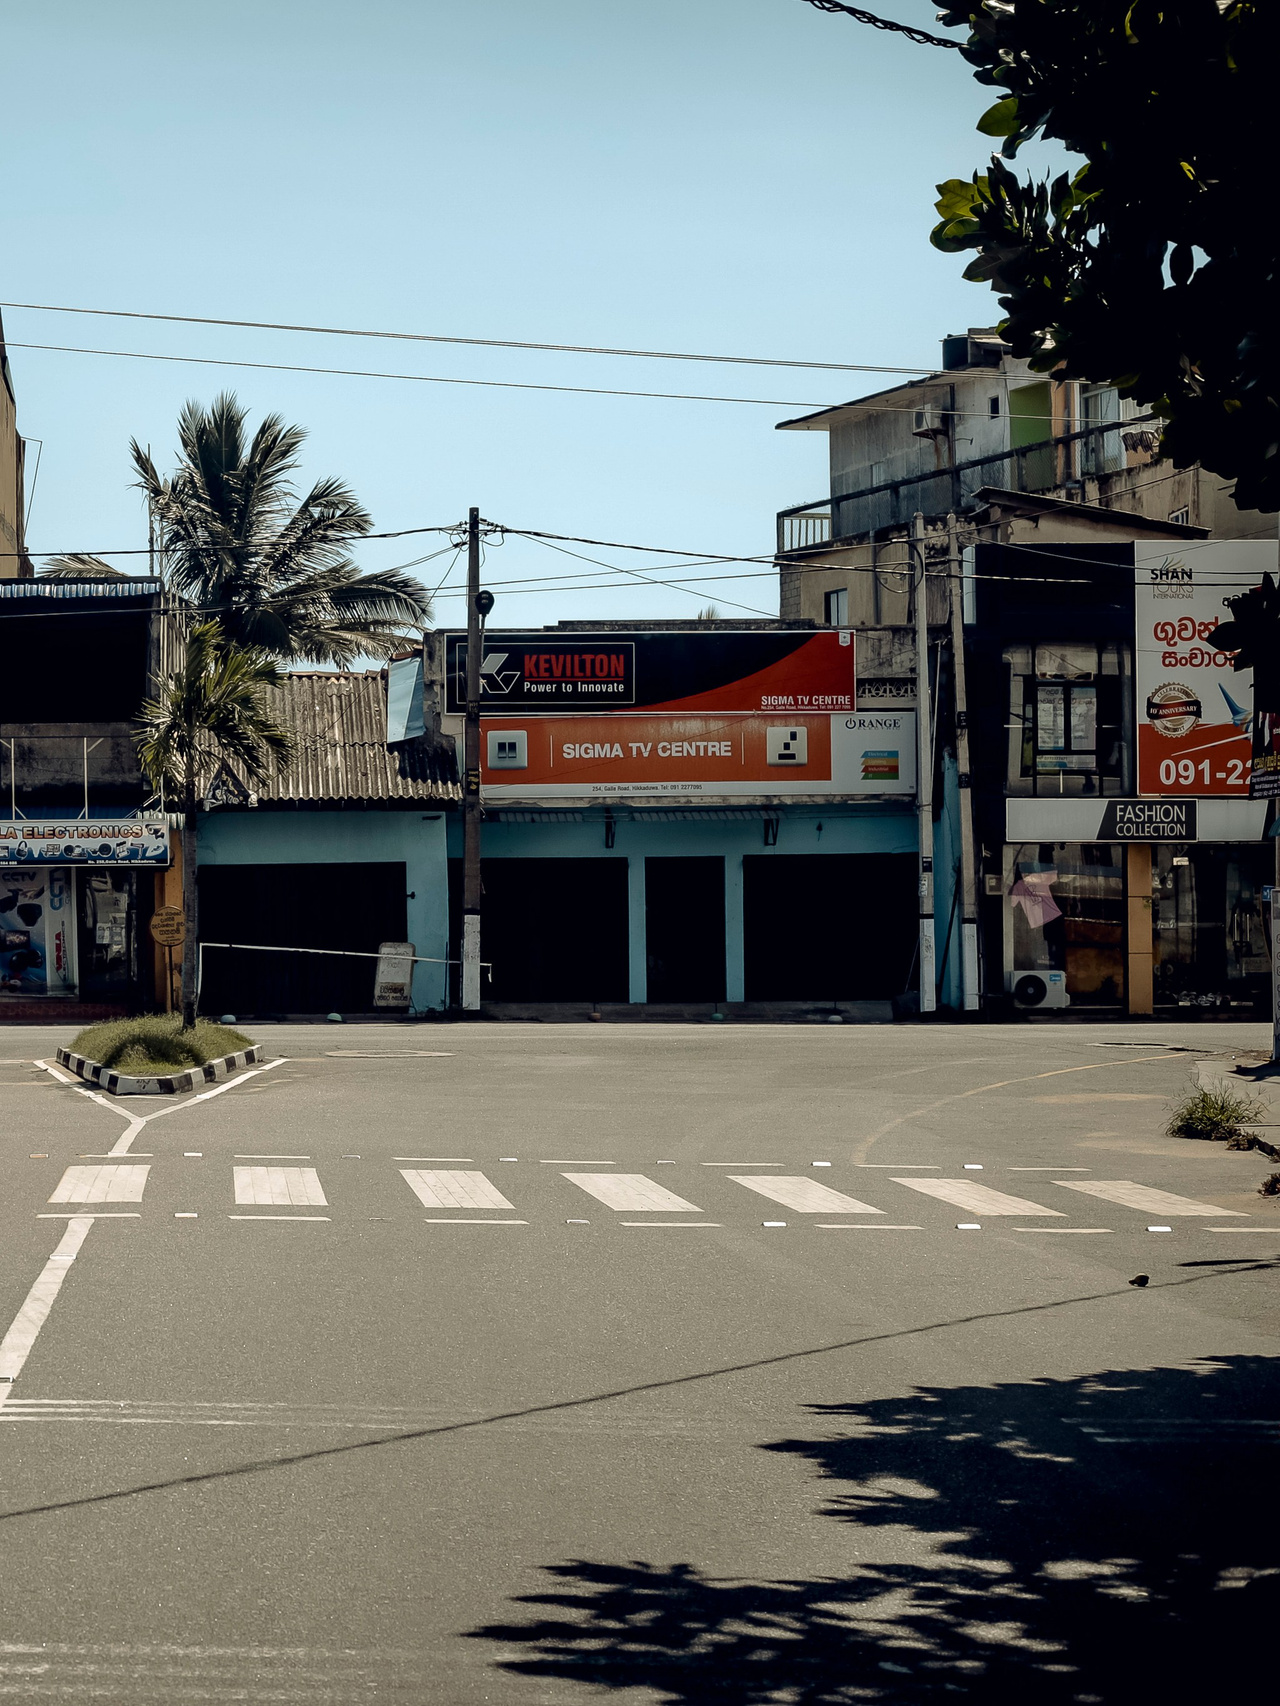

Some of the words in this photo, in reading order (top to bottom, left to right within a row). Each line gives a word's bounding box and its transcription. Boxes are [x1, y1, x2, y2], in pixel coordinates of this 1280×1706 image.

[1151, 568, 1193, 580] SHAN
[1151, 580, 1194, 593] TOURS
[524, 654, 625, 677] KEVILTON
[524, 682, 557, 692] Power
[562, 682, 572, 692] to
[577, 682, 625, 692] Innovate
[761, 695, 795, 705] SIGMA
[797, 695, 809, 705] TV
[812, 695, 851, 705] CENTRE
[1159, 706, 1198, 715] ANNIVERSARY
[563, 743, 624, 759] SIGMA
[629, 742, 653, 758] TV
[658, 741, 732, 757] CENTRE
[1116, 805, 1185, 822] FASHION
[22, 825, 143, 839] ELECTRONICS
[1116, 823, 1186, 836] COLLECTION
[2, 872, 36, 882] CCTV
